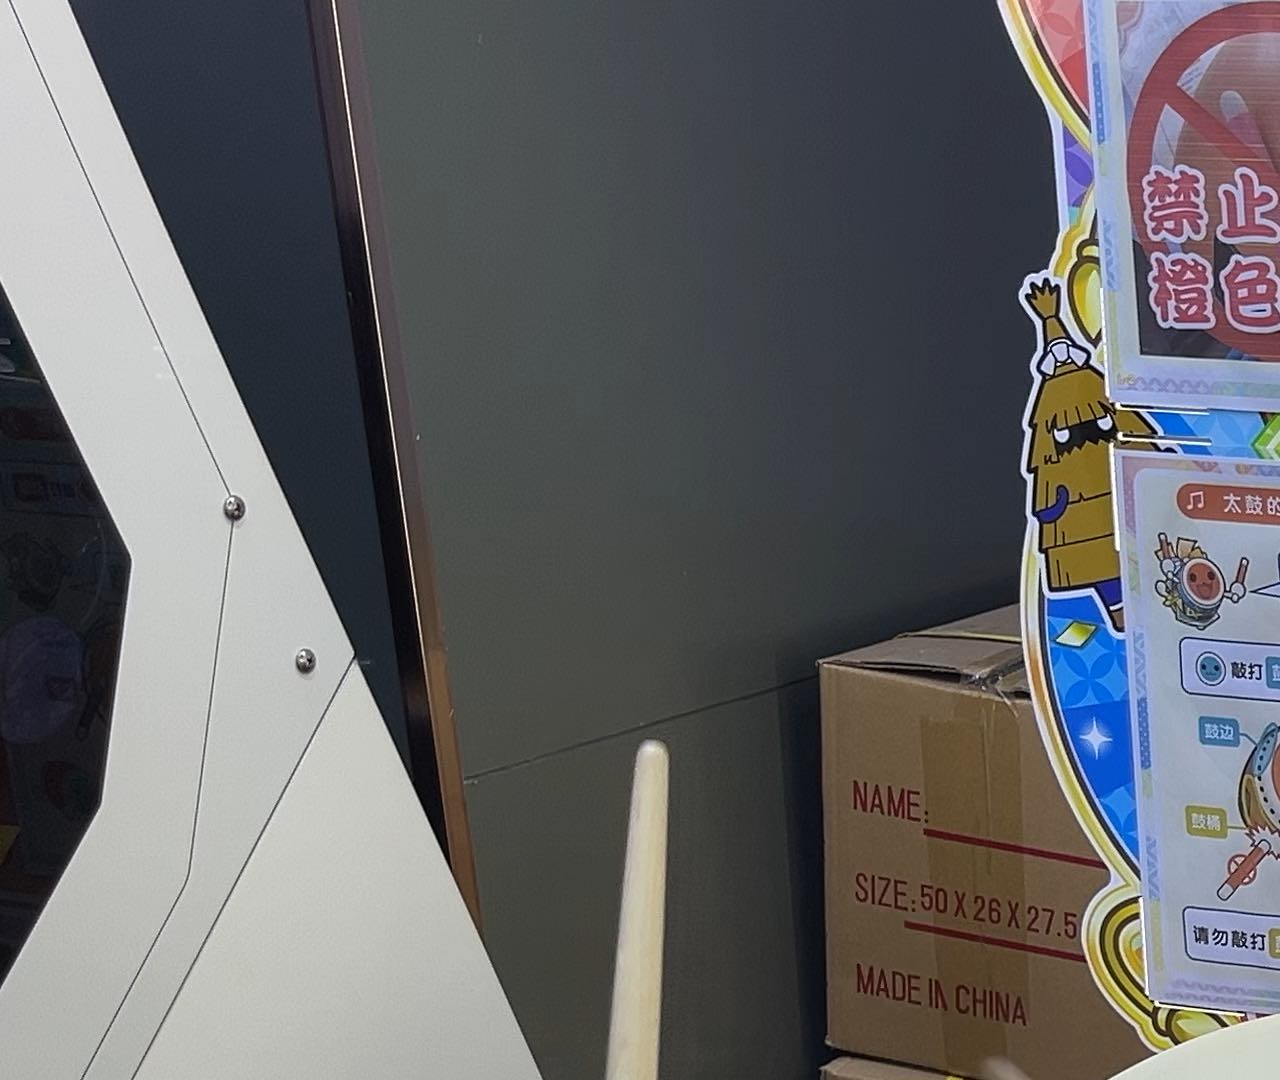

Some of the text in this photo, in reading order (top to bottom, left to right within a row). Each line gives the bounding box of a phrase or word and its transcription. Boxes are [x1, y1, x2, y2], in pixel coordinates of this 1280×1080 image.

[1230, 660, 1263, 682] 敲打
[1203, 723, 1235, 742] 鼓边
[852, 780, 930, 824] NAME:
[954, 889, 967, 920] X
[973, 894, 1001, 925] 26
[1006, 901, 1021, 929] X
[1027, 905, 1078, 940] 27.5
[1192, 925, 1266, 952] 请勿敲打
[855, 962, 1028, 1027] MADE IN CHINA
